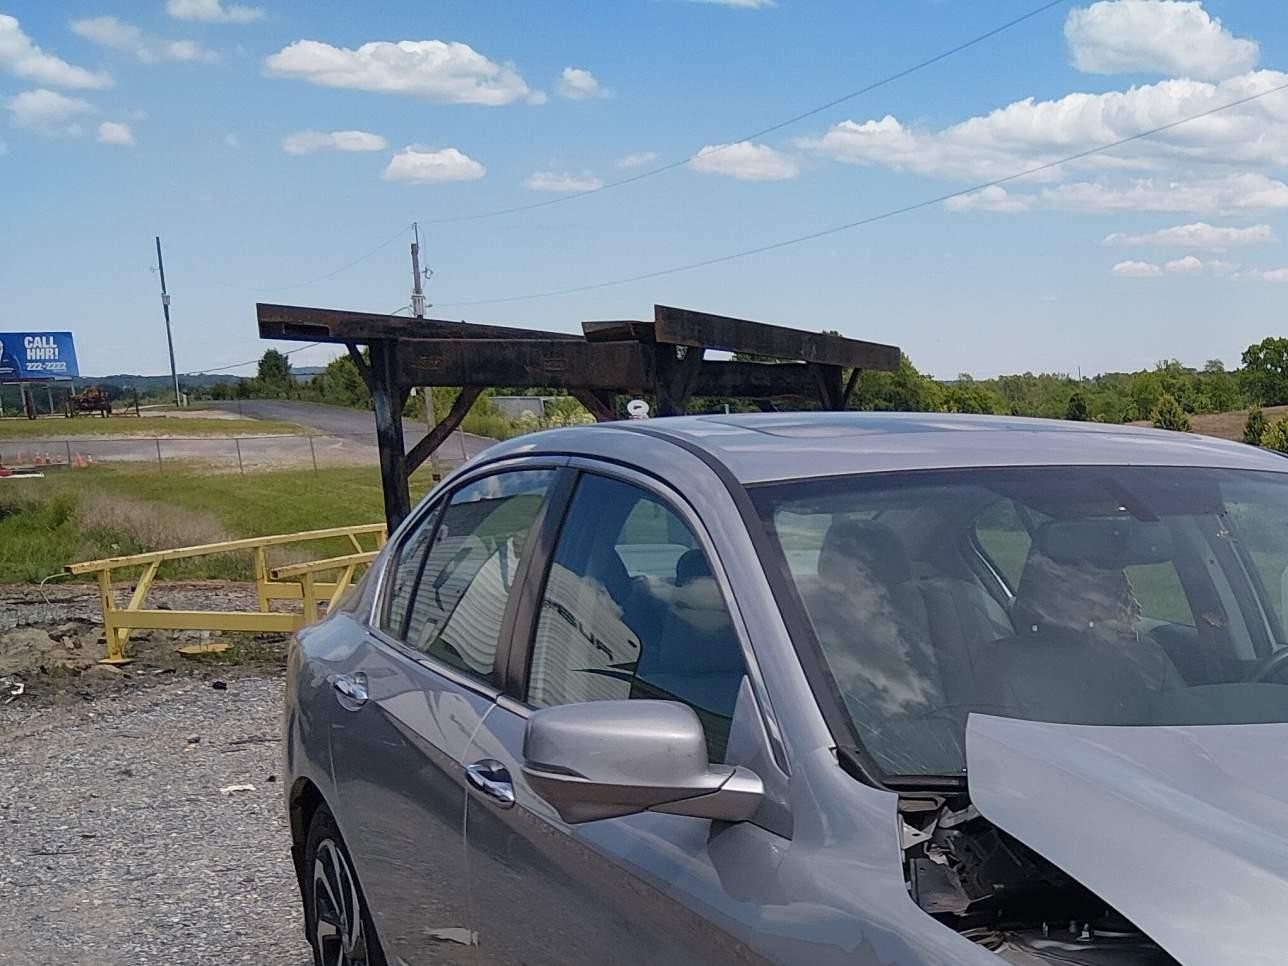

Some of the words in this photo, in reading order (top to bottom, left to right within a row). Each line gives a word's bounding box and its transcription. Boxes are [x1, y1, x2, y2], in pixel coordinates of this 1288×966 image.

[24, 336, 57, 348] CALL
[26, 348, 59, 360] HHR!
[25, 362, 67, 371] 222-2222
